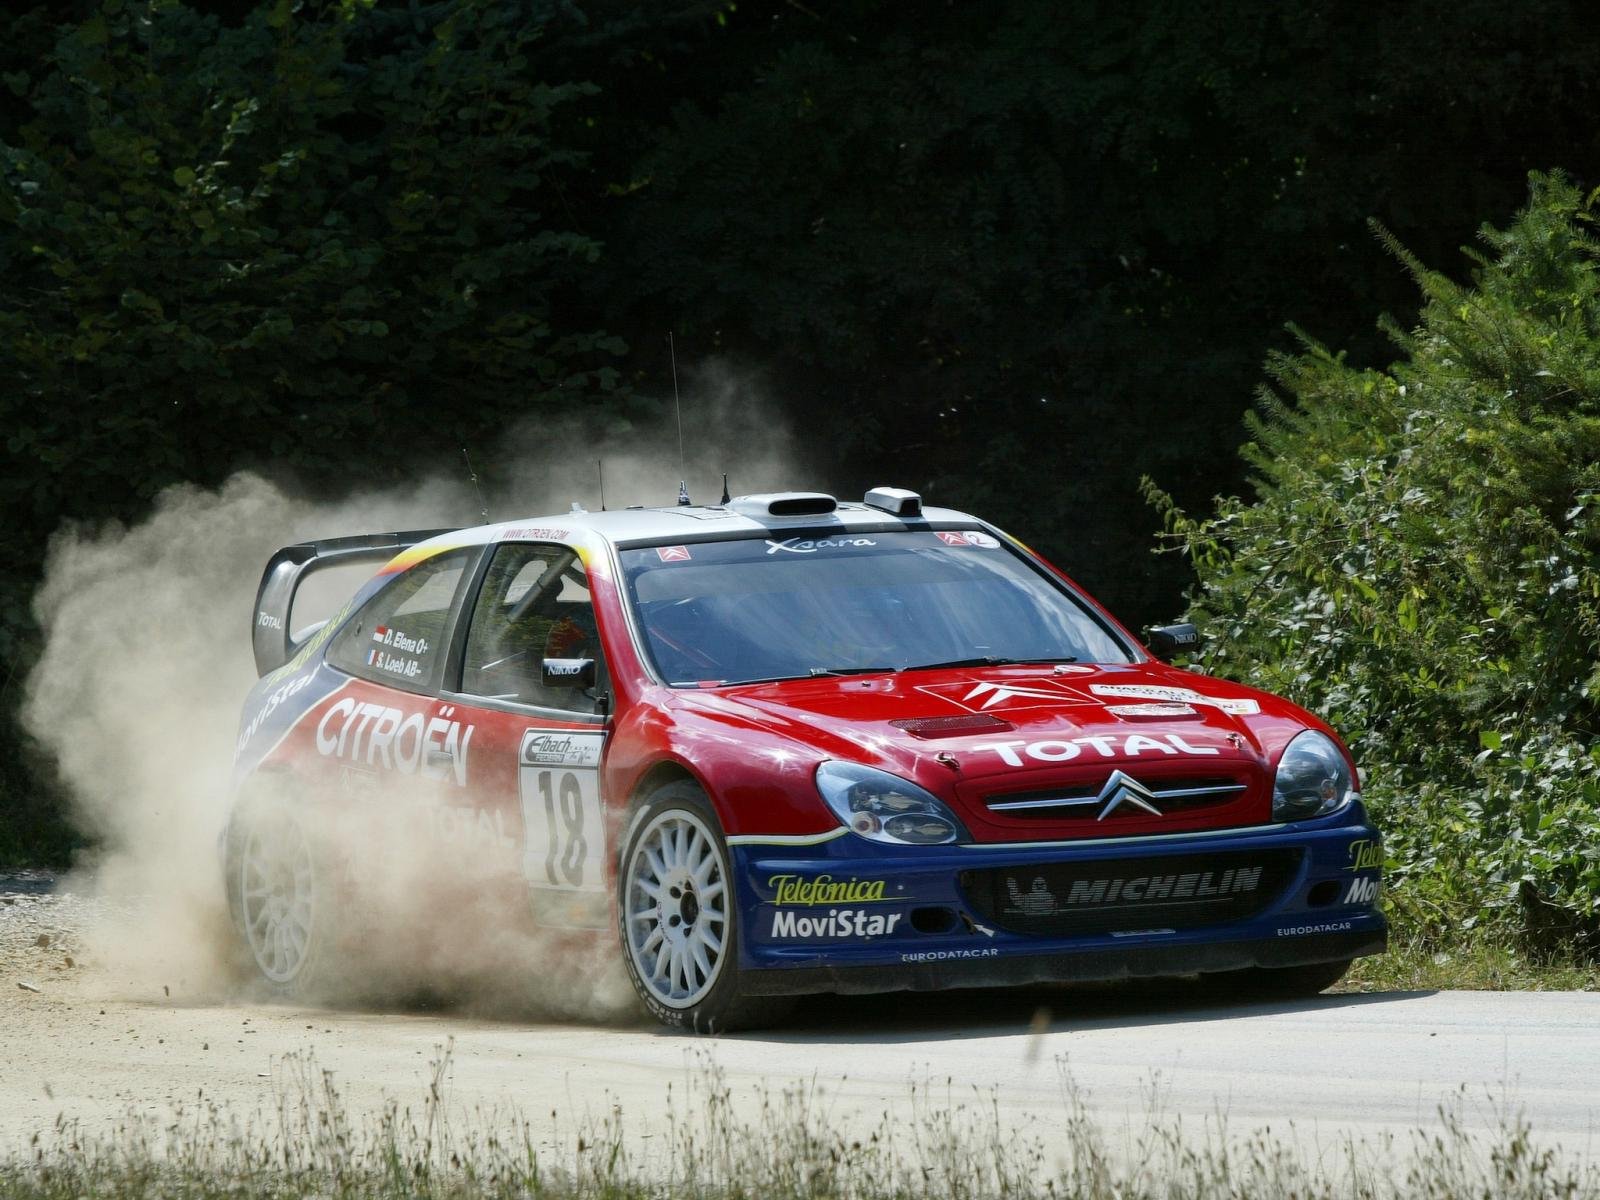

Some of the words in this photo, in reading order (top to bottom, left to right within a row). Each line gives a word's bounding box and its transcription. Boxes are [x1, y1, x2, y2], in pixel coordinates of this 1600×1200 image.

[764, 536, 877, 554] Xsara
[257, 610, 283, 630] TOTAL
[383, 628, 393, 646] D.
[392, 631, 417, 653] Elena
[415, 638, 428, 655] O+
[375, 651, 384, 668] S.
[383, 653, 405, 674] Loeb
[403, 659, 421, 677] AB-
[316, 697, 475, 787] CITROËN
[974, 732, 1220, 767] TOTAL
[538, 770, 588, 888] 18
[1067, 866, 1263, 904] MICHELIN
[771, 909, 902, 937] MoviStar
[1277, 921, 1351, 936] EURODATACAR
[901, 948, 999, 963] EURODATACAR
